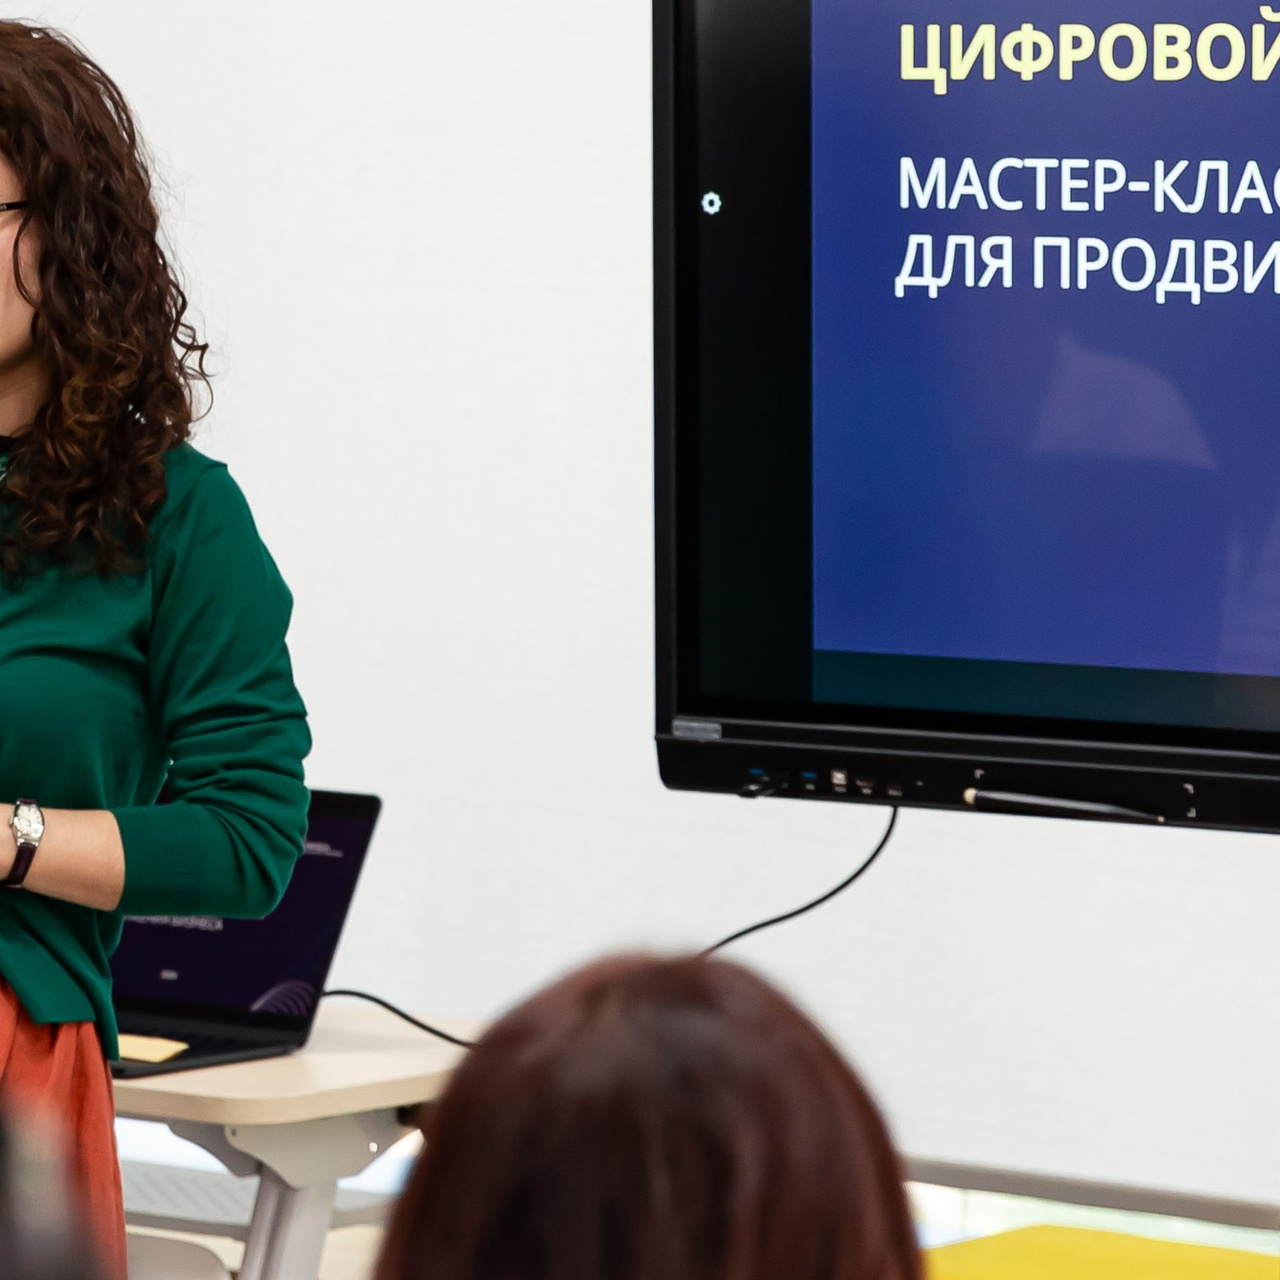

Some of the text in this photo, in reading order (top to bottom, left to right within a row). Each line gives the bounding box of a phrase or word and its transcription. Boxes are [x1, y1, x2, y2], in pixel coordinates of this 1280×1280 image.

[899, 5, 1280, 95] ЦИФРОВОЙ
[899, 156, 1280, 215] МАСТЕР-КЛА
[893, 234, 1280, 305] ДЛЯ ПРОДВИ
